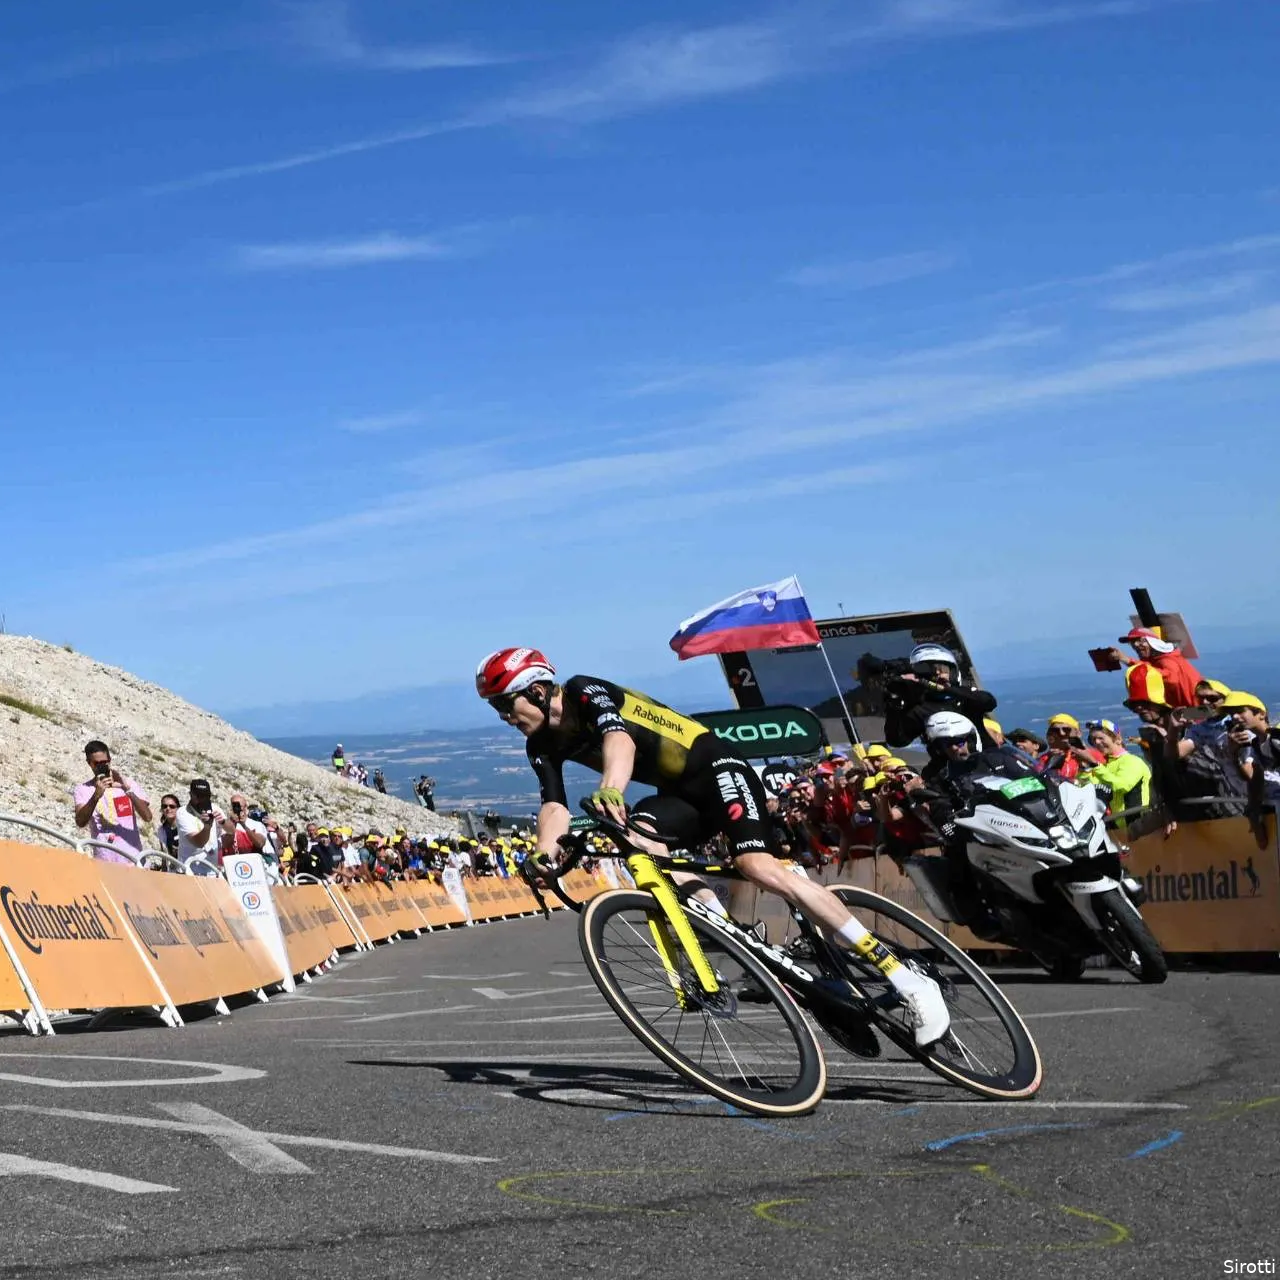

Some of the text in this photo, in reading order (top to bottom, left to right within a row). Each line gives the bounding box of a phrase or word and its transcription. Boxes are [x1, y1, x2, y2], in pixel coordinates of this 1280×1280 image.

[820, 625, 857, 638] ance
[739, 668, 756, 687] 2
[632, 704, 685, 736] Rabobank
[714, 721, 809, 742] KODA
[765, 772, 797, 790] 150
[736, 839, 766, 851] nimbl
[1141, 859, 1239, 904] tinental
[0, 885, 110, 955] Continental
